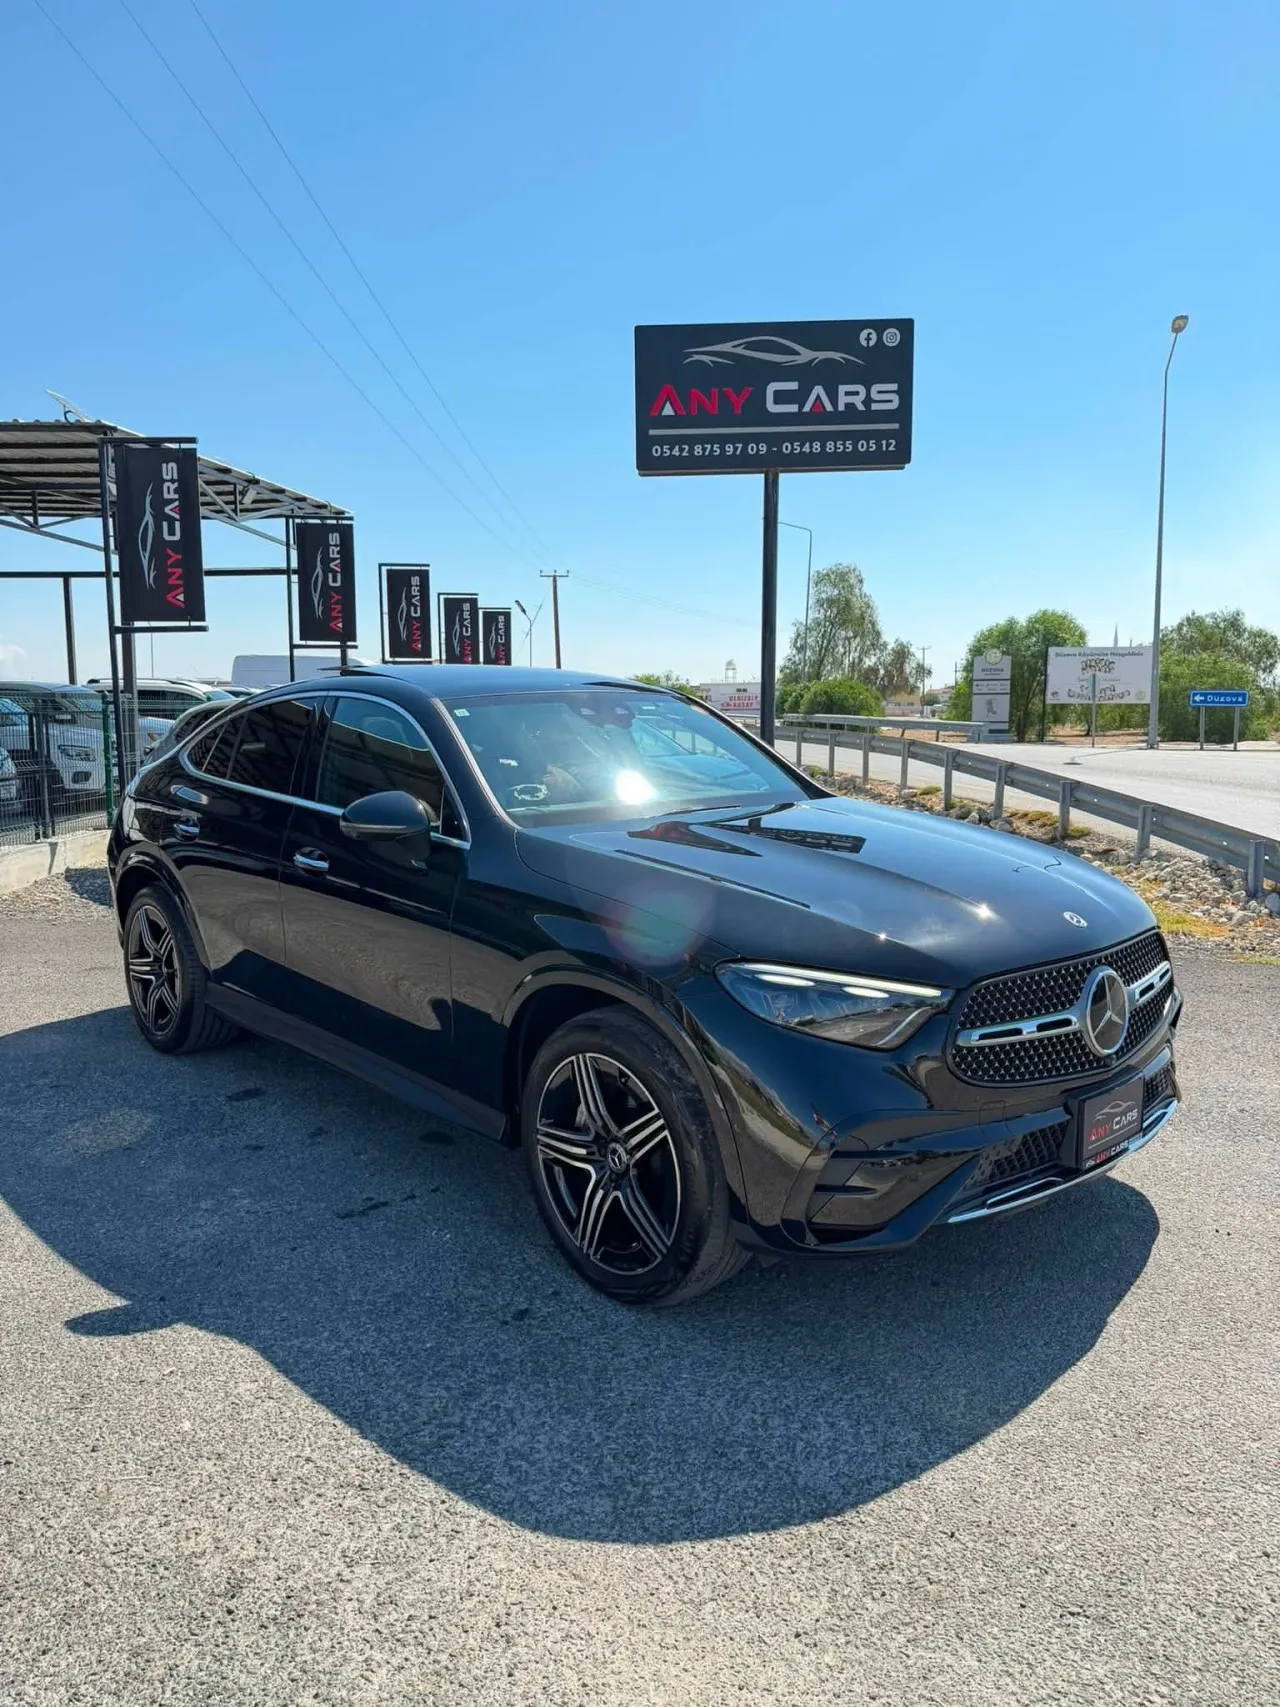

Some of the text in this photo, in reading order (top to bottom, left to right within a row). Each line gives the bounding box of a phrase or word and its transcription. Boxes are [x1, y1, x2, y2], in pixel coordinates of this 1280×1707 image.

[650, 381, 900, 417] ANY CARS
[652, 444, 689, 457] 0542
[694, 443, 721, 456] 875
[725, 443, 742, 456] 97
[748, 442, 767, 455] 09
[782, 441, 821, 454] 0548
[826, 440, 853, 453] 855
[858, 440, 876, 452] 05
[881, 439, 896, 452] 12
[161, 461, 185, 608] ANY CARS
[328, 532, 343, 633] ANY CARS
[411, 576, 422, 651] ANY CARS
[1089, 1109, 1138, 1141] ANY CARS
